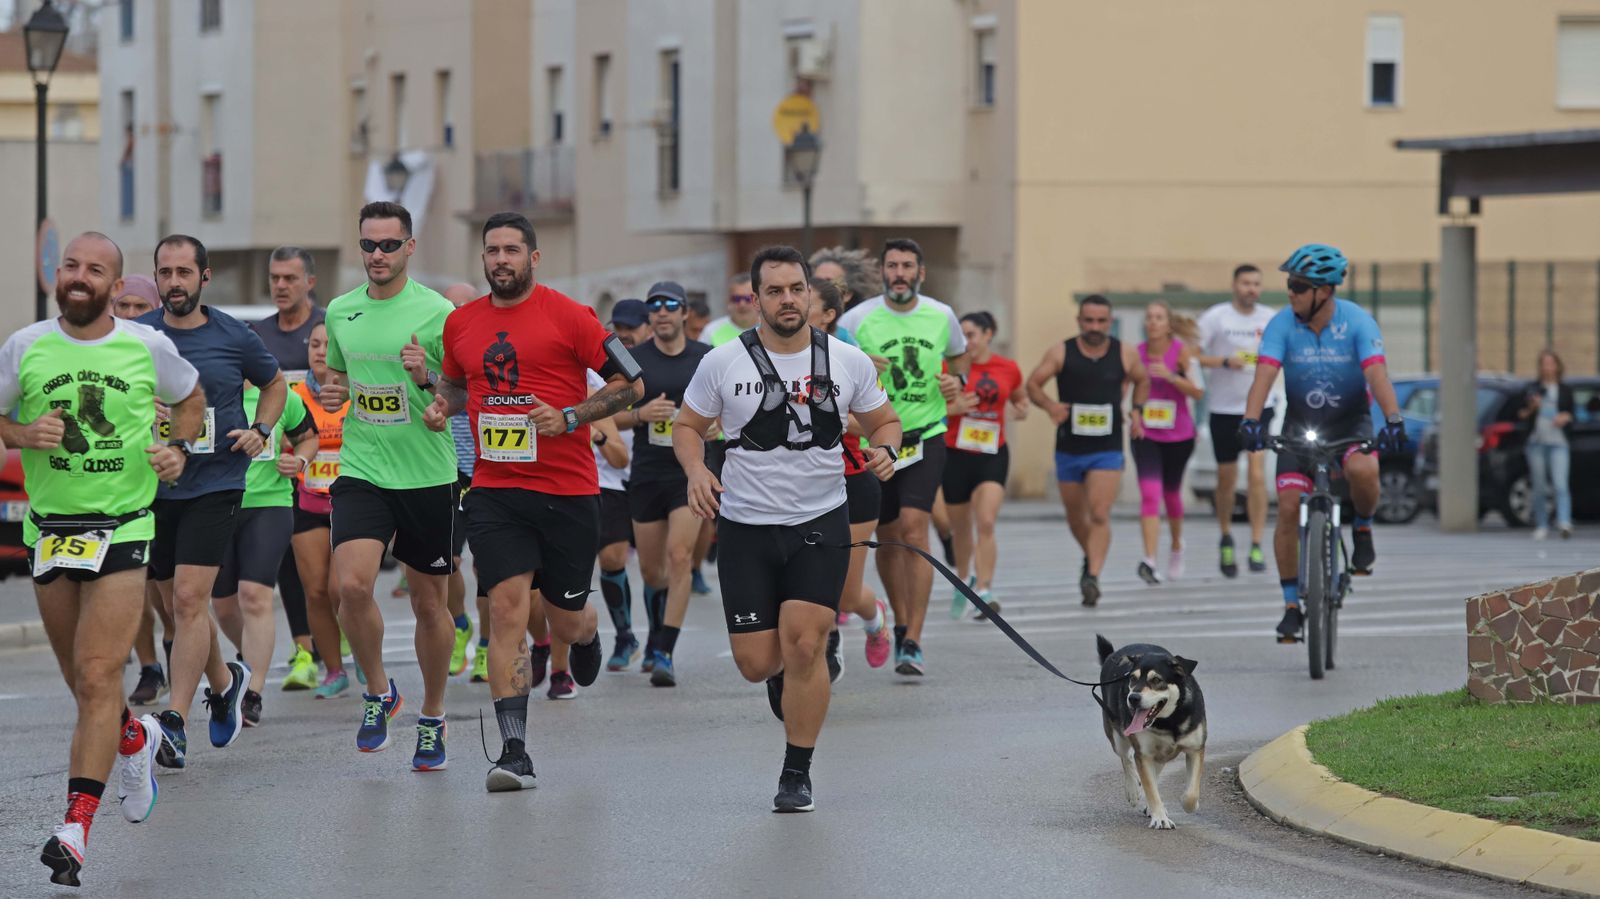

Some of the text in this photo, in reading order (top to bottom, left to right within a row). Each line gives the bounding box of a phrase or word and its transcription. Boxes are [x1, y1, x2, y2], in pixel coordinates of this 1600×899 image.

[42, 373, 74, 396] CARRERA
[357, 394, 401, 412] 403
[482, 427, 527, 447] 177
[50, 537, 87, 557] 25
